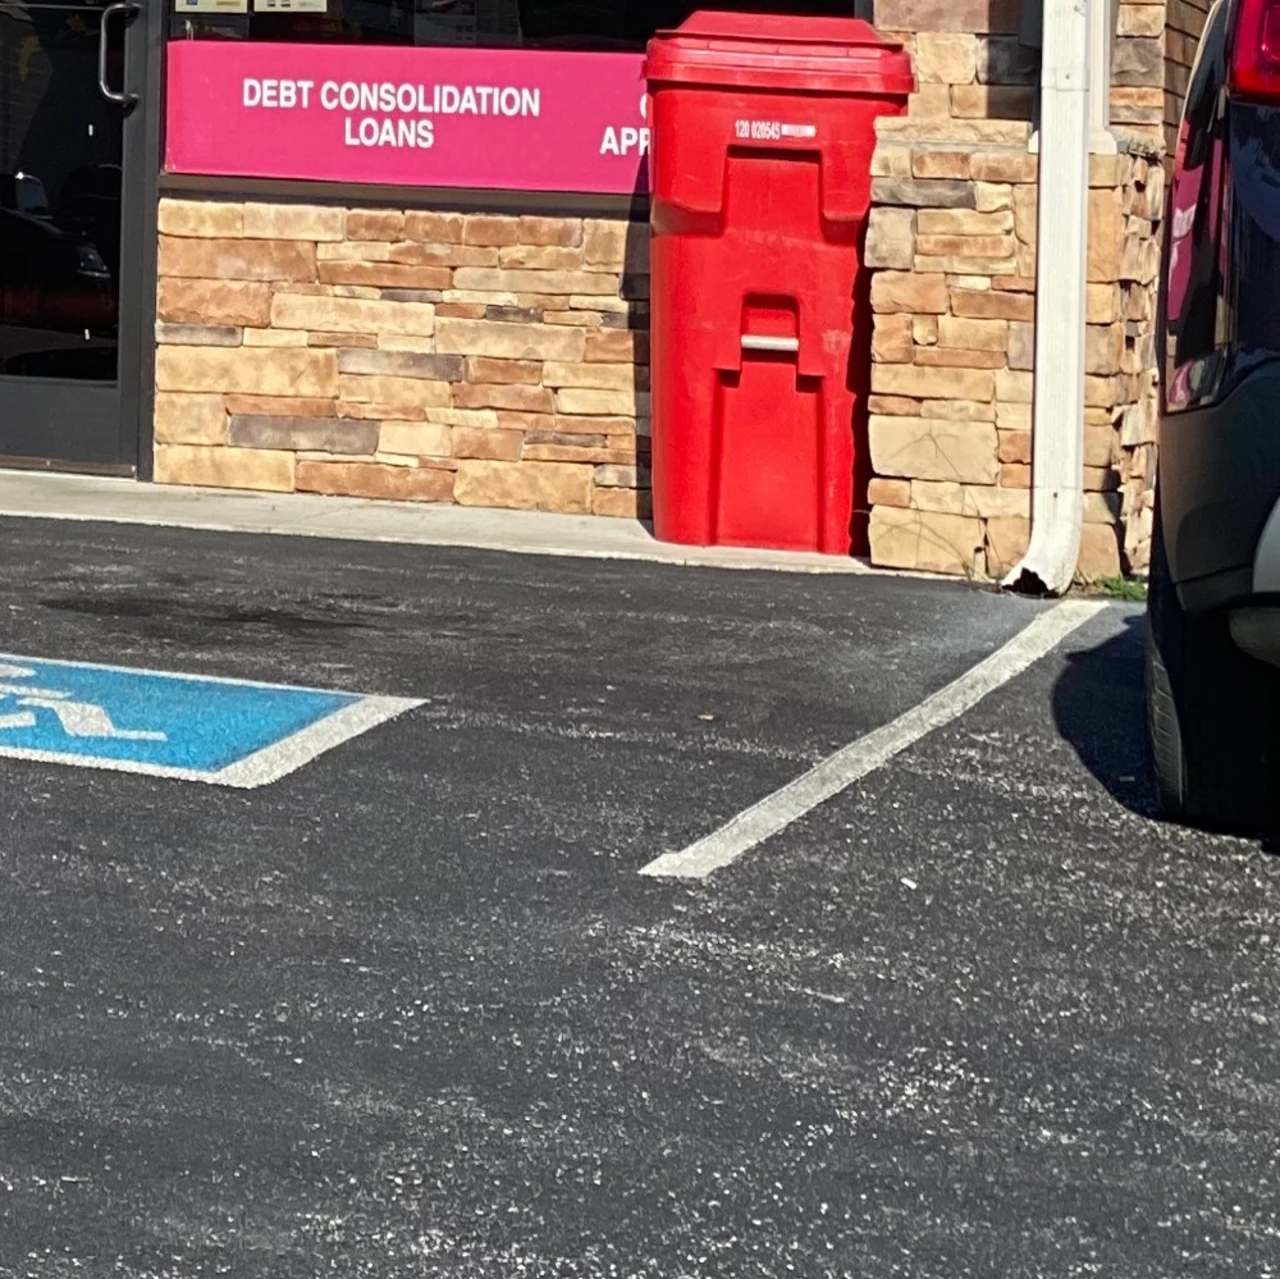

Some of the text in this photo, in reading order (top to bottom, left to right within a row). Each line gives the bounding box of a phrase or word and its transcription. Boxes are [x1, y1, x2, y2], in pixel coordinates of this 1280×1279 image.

[242, 77, 540, 116] DEBT CONSOLIDATION
[345, 117, 434, 148] LOANS
